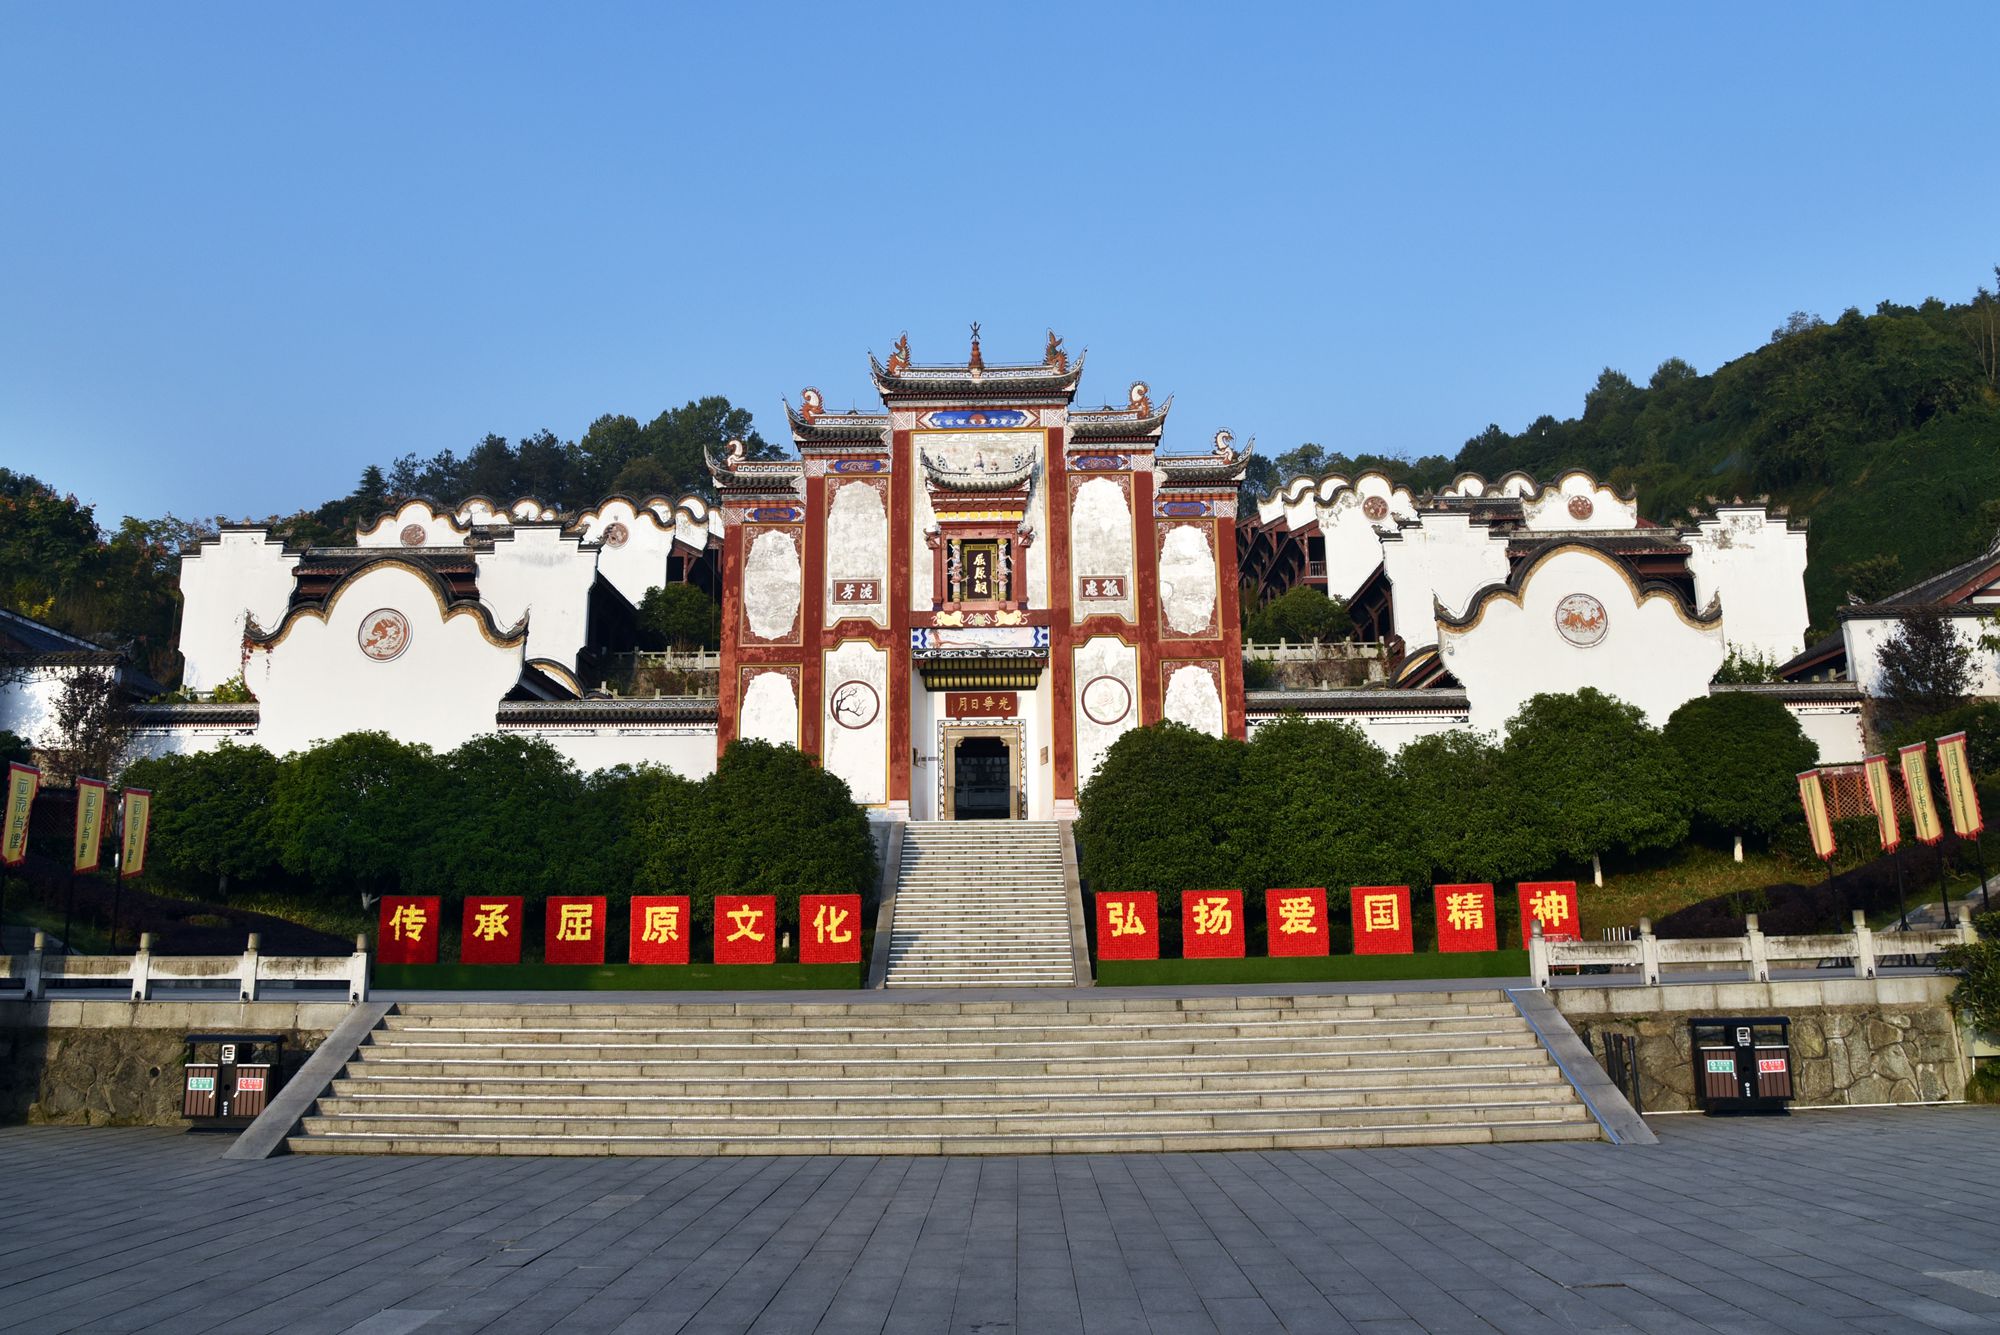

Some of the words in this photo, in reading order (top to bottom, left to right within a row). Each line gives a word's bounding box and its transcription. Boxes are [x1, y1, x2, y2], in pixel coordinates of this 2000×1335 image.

[973, 552, 988, 595] 屈原祠
[389, 903, 852, 945] 传承屈原文化
[1106, 890, 1569, 937] 弘扬爱国精神
